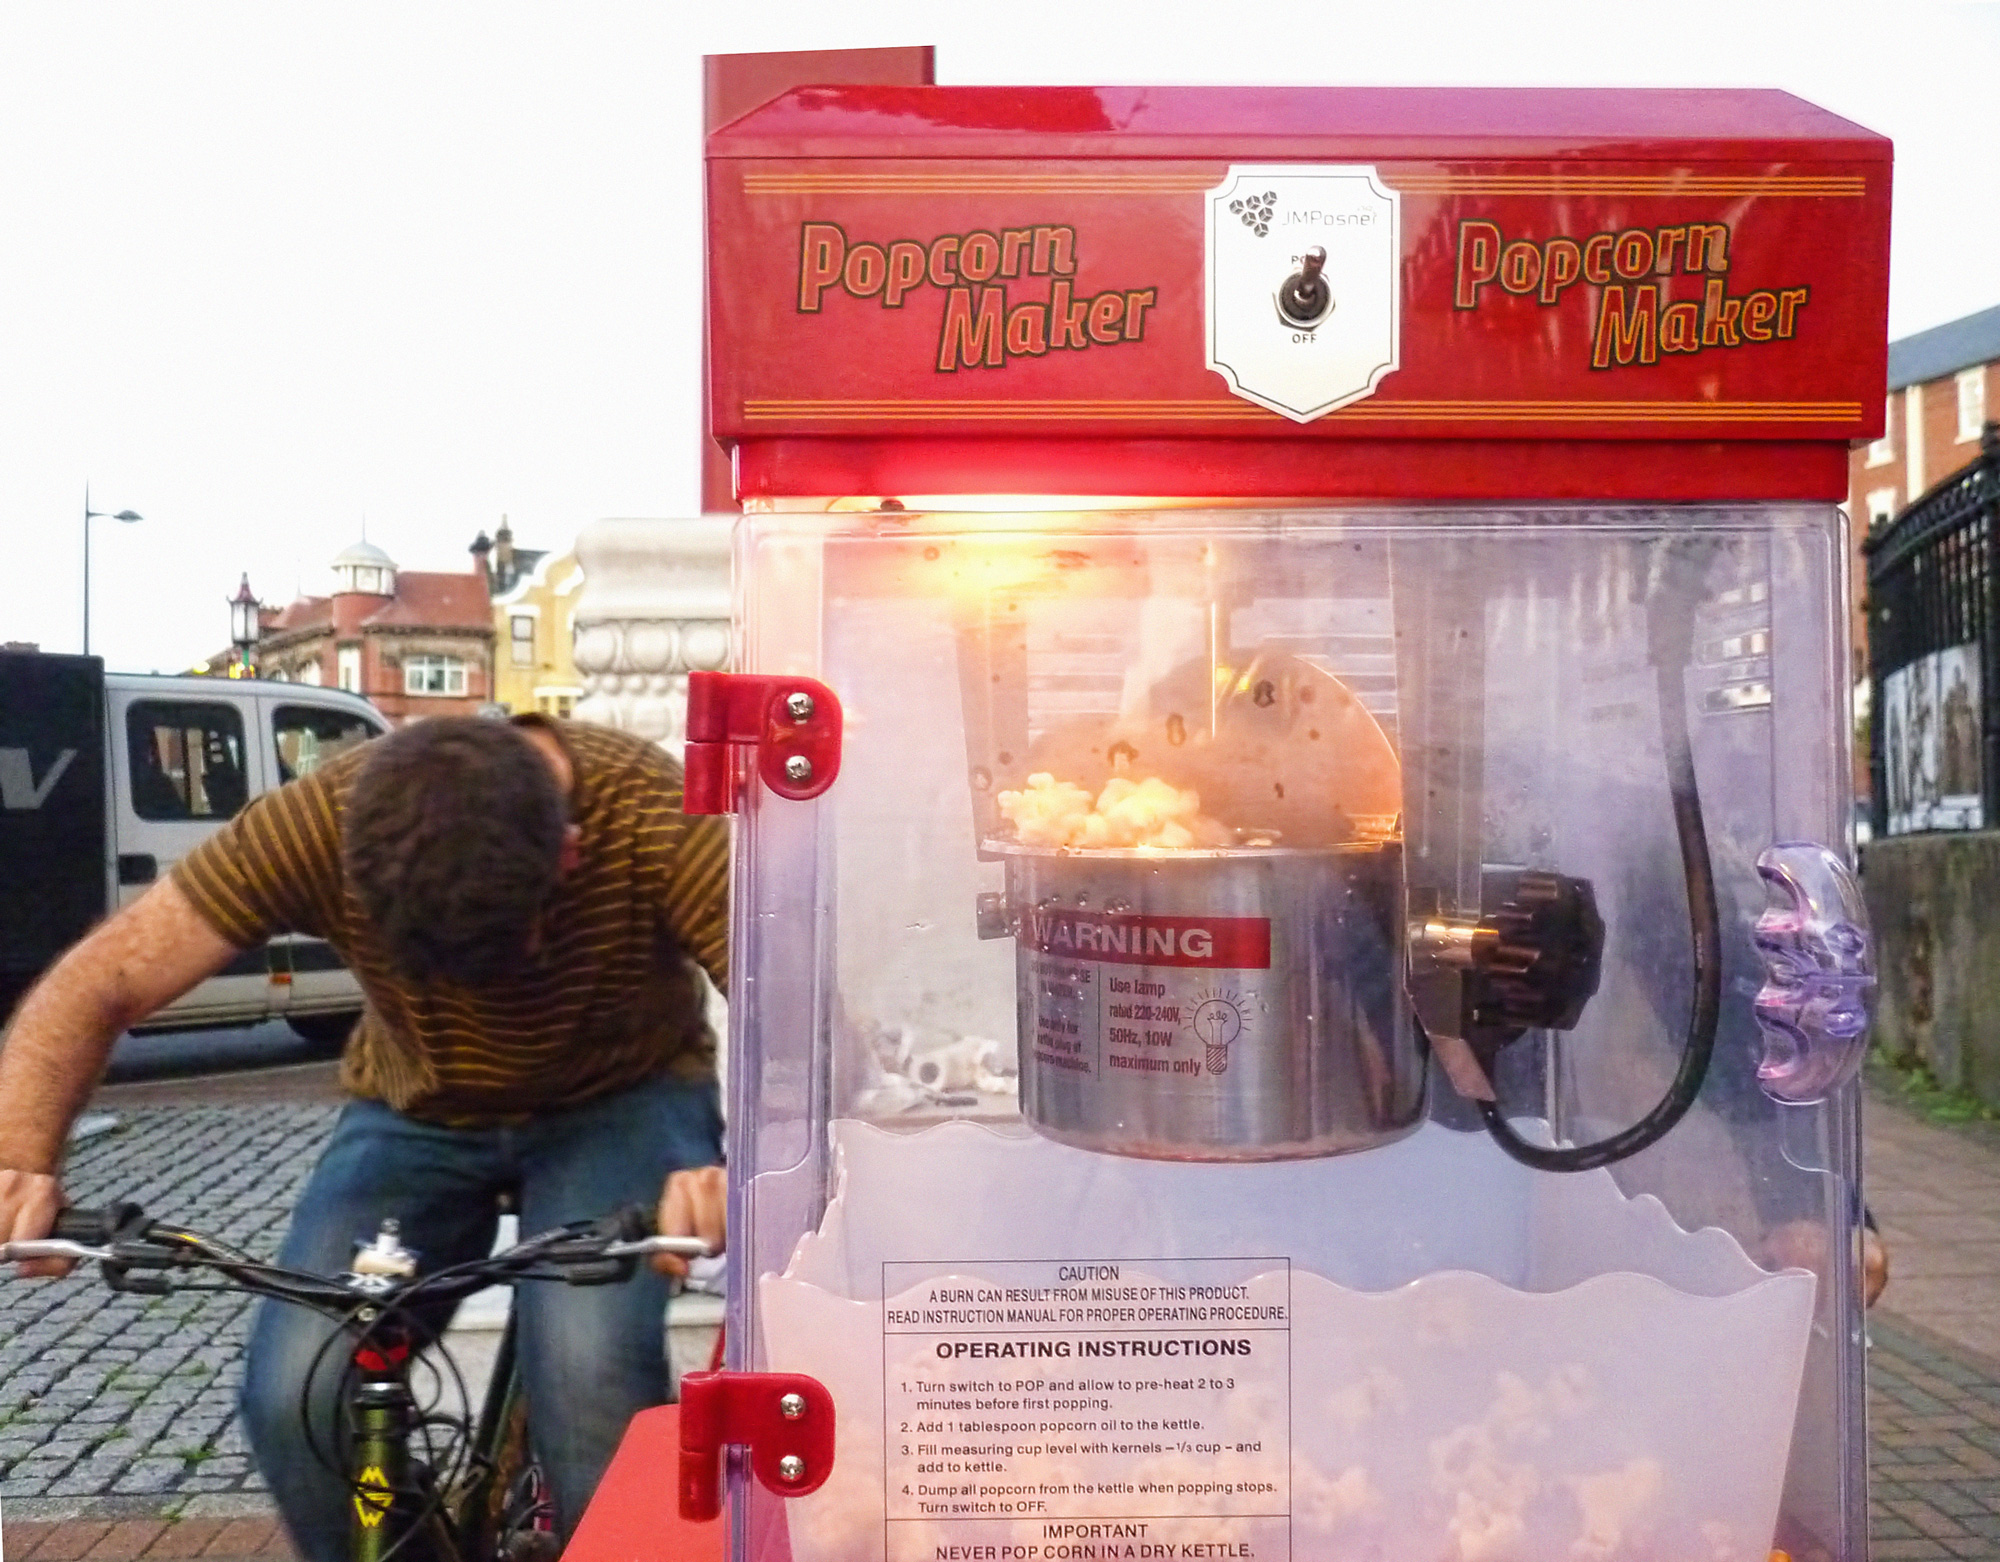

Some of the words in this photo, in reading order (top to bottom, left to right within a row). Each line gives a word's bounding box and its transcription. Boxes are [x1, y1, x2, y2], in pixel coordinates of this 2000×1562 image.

[797, 221, 1077, 314] Popcorn
[1453, 217, 1732, 311] Popcorn
[935, 276, 1157, 373] Maker
[1590, 277, 1811, 371] Maker
[1292, 333, 1318, 345] OFF
[1033, 916, 1213, 958] WARNING
[1109, 977, 1131, 994] Use
[1134, 979, 1166, 999] lamp
[1109, 1027, 1142, 1048] 50Hz,
[1145, 1029, 1173, 1047] 10W
[1109, 1054, 1170, 1073] maximum
[1173, 1058, 1202, 1077] only
[1058, 1265, 1120, 1282] CAUTION
[928, 1289, 939, 1304] A
[939, 1289, 975, 1304] BURN
[976, 1288, 1003, 1304] CAN
[1005, 1288, 1052, 1303] RESULT
[1052, 1287, 1089, 1303] FROM
[1091, 1286, 1139, 1302] MISUSE
[1139, 1286, 1157, 1302] OF
[1158, 1286, 1187, 1302] THIS
[1188, 1285, 1250, 1301] PRODUCT.
[887, 1309, 921, 1325] READ
[922, 1308, 1005, 1325] INSTRUCTION
[1006, 1308, 1058, 1324] MANUAL
[1058, 1307, 1085, 1323] FOR
[1086, 1307, 1136, 1323] PROPER
[1137, 1305, 1208, 1322] OPERATING
[1209, 1305, 1289, 1321] PROCEDURE.
[935, 1340, 1071, 1359] OPERATING
[1077, 1338, 1252, 1358] INSTRUCTIONS
[900, 1381, 913, 1394] 1.
[915, 1380, 946, 1394] Turn
[948, 1379, 995, 1393] switch
[997, 1380, 1013, 1393] to
[1015, 1379, 1046, 1393] POP
[1047, 1378, 1075, 1392] and
[1077, 1378, 1115, 1392] allow
[1117, 1379, 1132, 1391] to
[1135, 1377, 1195, 1393] pre-heat
[1197, 1377, 1207, 1390] 2
[1208, 1377, 1224, 1390] to
[1226, 1377, 1235, 1390] 3
[916, 1397, 973, 1411] minutes
[974, 1397, 1020, 1411] before
[1022, 1397, 1051, 1410] first
[1052, 1396, 1113, 1413] popping.
[900, 1421, 913, 1434] 2.
[916, 1420, 944, 1433] Add
[947, 1420, 954, 1433] 1
[958, 1420, 1037, 1436] tablespoon
[1038, 1421, 1098, 1435] popcorn
[1099, 1419, 1118, 1433] oil
[1119, 1419, 1135, 1432] to
[1136, 1418, 1159, 1431] the
[1162, 1418, 1205, 1431] kettle.
[900, 1444, 914, 1457] 3.
[917, 1443, 938, 1456] Fill
[940, 1442, 1014, 1458] measuring
[1016, 1445, 1043, 1458] cup
[1045, 1442, 1078, 1455] level
[1079, 1441, 1109, 1454] with
[1111, 1441, 1163, 1454] kernels
[1195, 1443, 1222, 1456] cup
[1235, 1440, 1262, 1453] and
[917, 1461, 945, 1474] add
[946, 1461, 962, 1474] to
[964, 1460, 1007, 1474] kettle.
[901, 1484, 914, 1496] 4.
[917, 1484, 958, 1499] Dump
[960, 1482, 977, 1496] all
[979, 1485, 1037, 1499] popcorn
[1038, 1482, 1070, 1495] from
[1072, 1482, 1095, 1495] the
[1097, 1482, 1135, 1494] kettle
[1138, 1481, 1175, 1494] when
[1177, 1480, 1234, 1497] popping
[1236, 1481, 1278, 1495] stops.
[917, 1501, 949, 1514] Turn
[951, 1500, 997, 1514] switch
[998, 1501, 1014, 1513] to
[1015, 1500, 1048, 1513] OFF.
[1043, 1523, 1149, 1539] IMPORTANT
[935, 1545, 997, 1560] NEVER
[1001, 1545, 1040, 1560] POP
[1041, 1543, 1098, 1560] CORN
[1099, 1543, 1120, 1560] IN
[1123, 1543, 1136, 1559] A
[1140, 1543, 1177, 1560] DRY
[1180, 1542, 1255, 1560] KETTLE.
